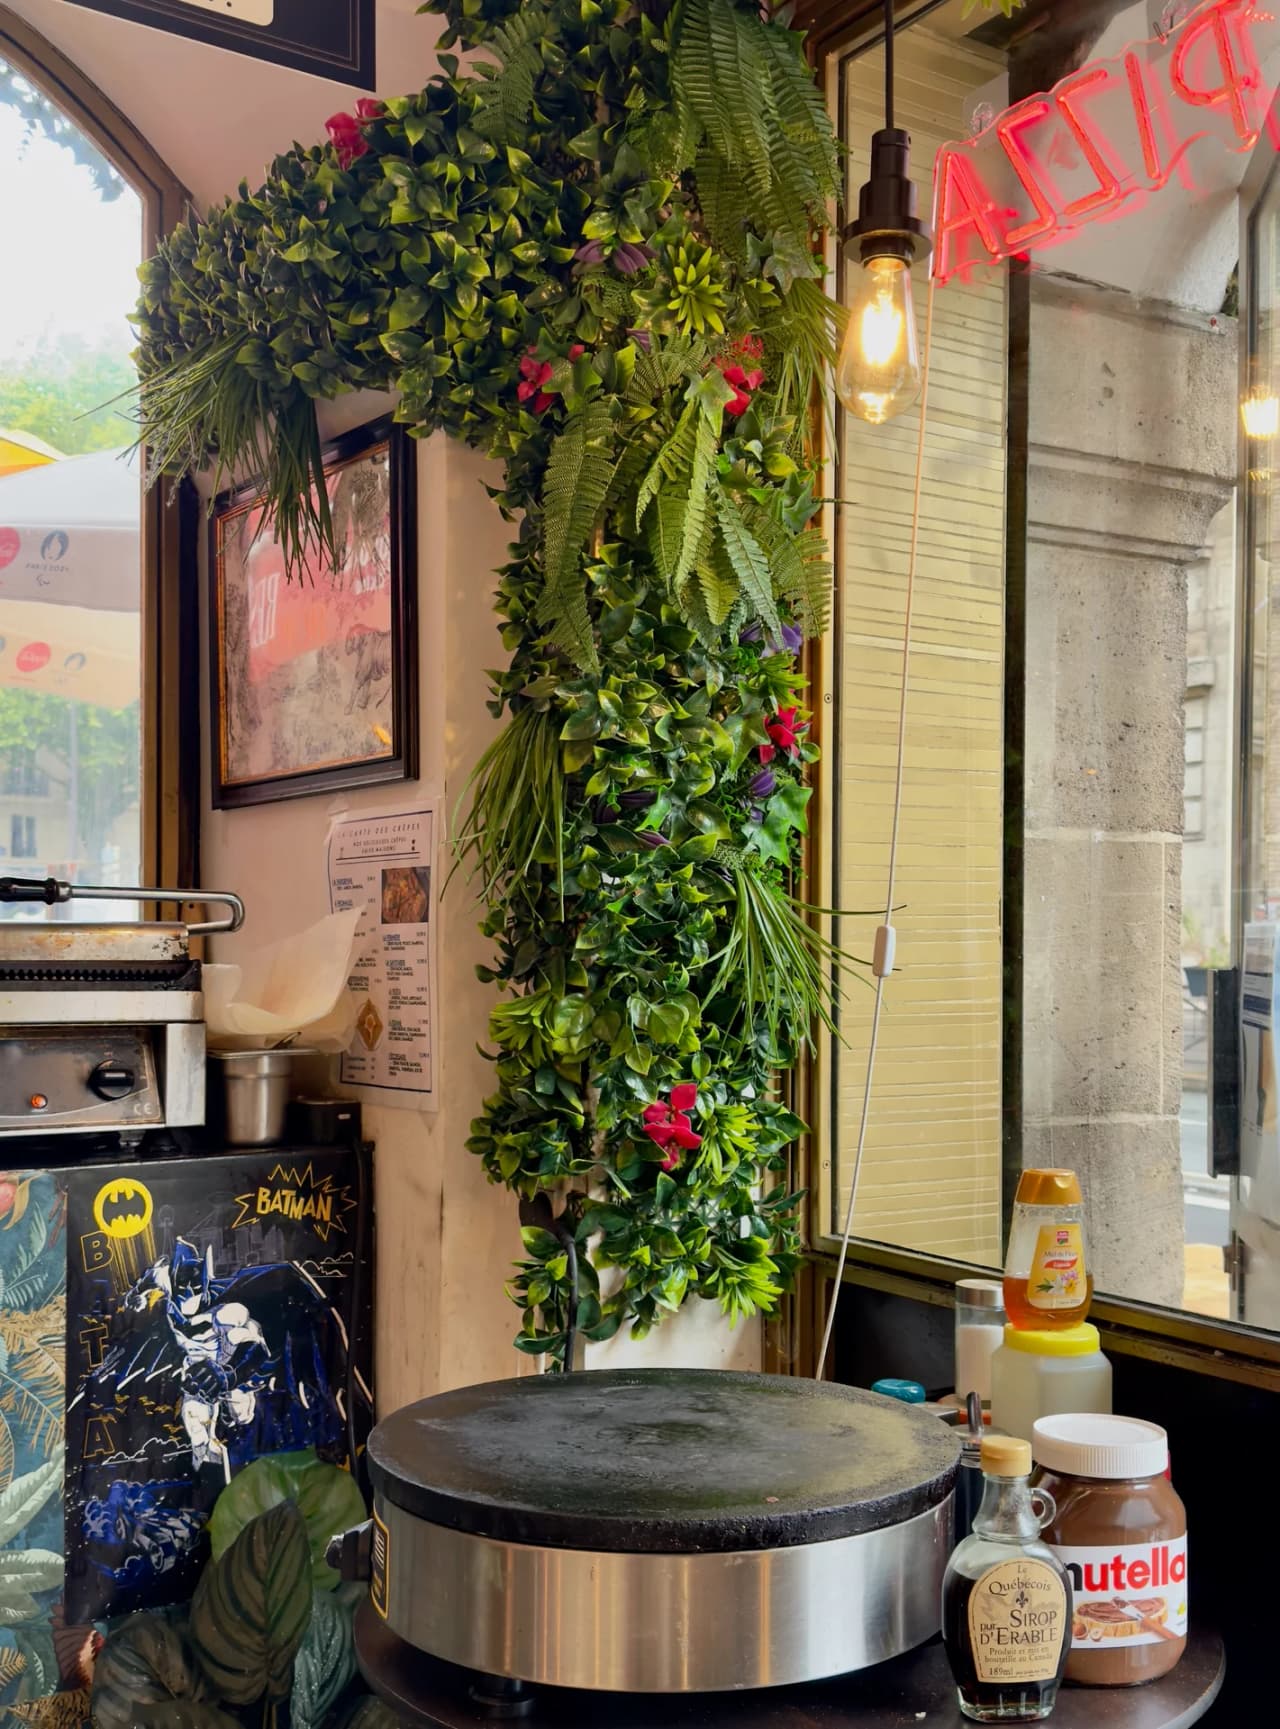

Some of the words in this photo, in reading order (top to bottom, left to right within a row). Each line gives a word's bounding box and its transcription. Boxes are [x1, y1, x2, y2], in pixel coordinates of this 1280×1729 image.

[256, 1187, 333, 1222] BATMAN
[1017, 1565, 1028, 1574] Le
[1065, 1546, 1185, 1592] nutella
[988, 1577, 1052, 1596] Québécois
[980, 1623, 996, 1632] pur
[989, 1648, 1017, 1656] Produit
[989, 1668, 1014, 1676] 189ml
